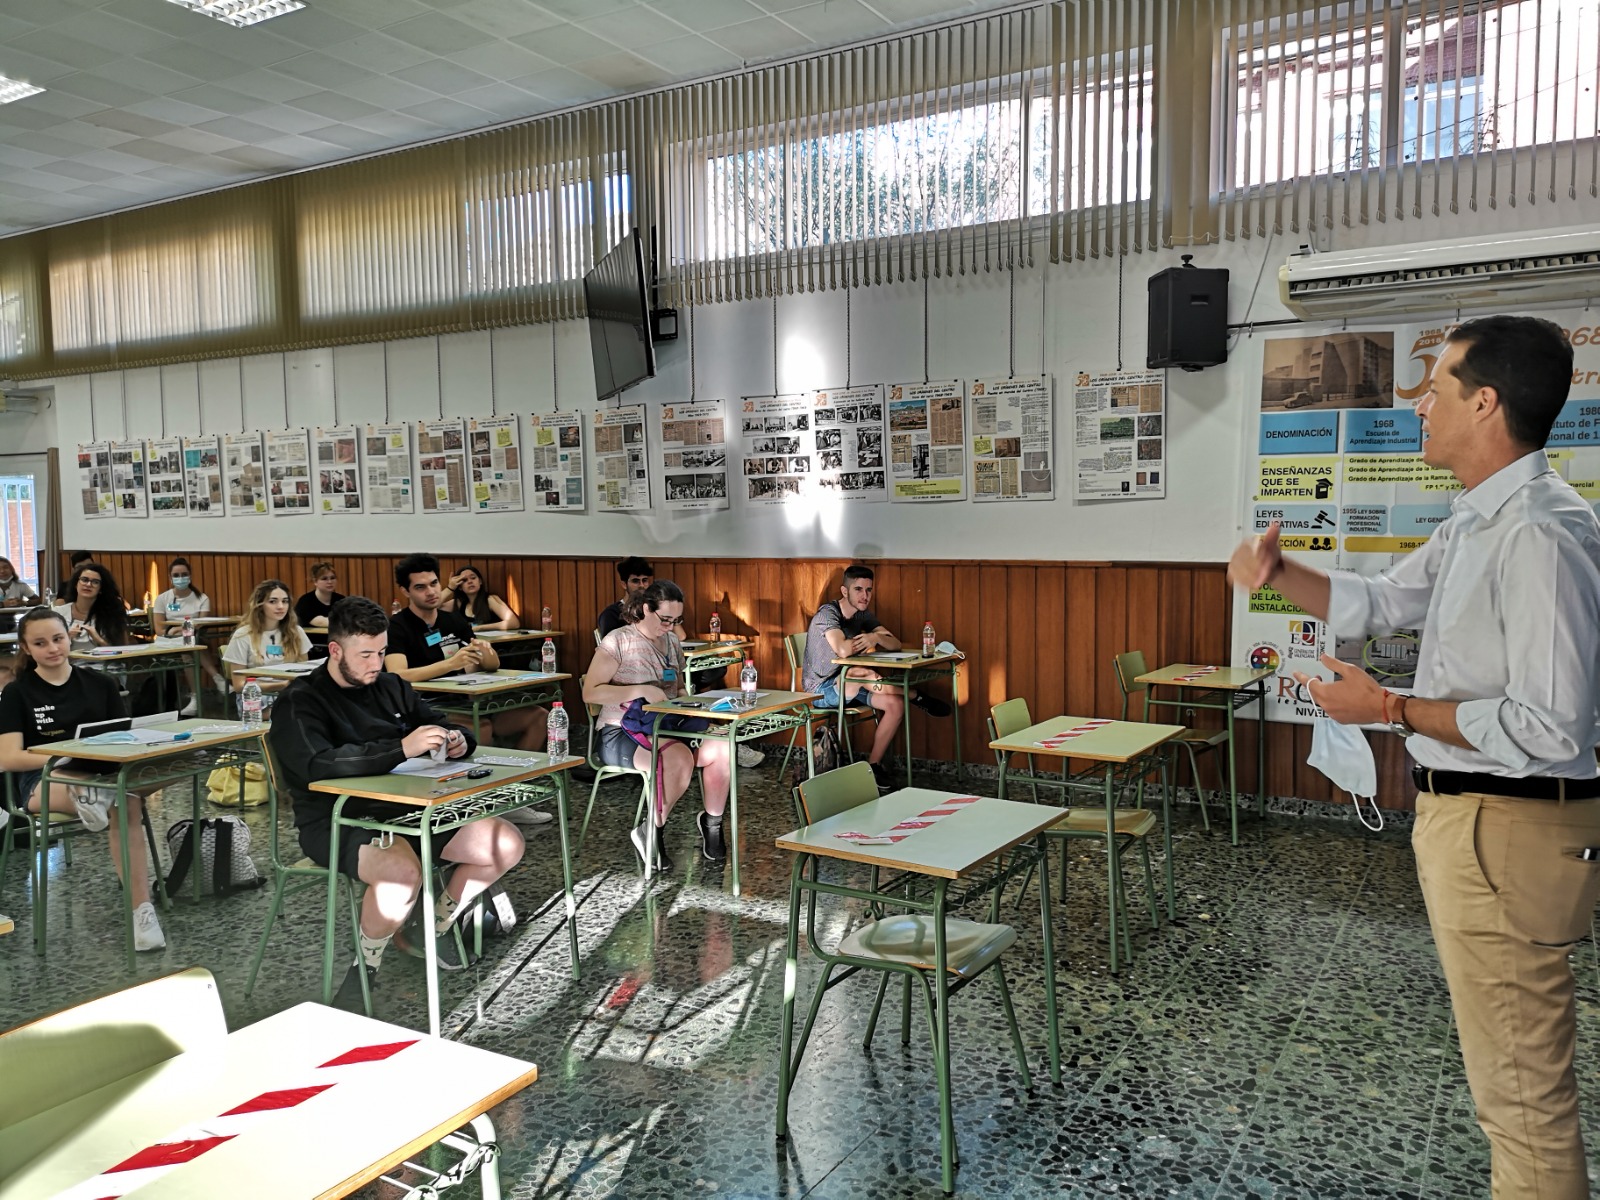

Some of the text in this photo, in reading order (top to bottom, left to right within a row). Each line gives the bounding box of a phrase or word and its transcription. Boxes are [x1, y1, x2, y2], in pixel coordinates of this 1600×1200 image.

[1419, 337, 1442, 345] 2018
[1373, 420, 1394, 428] 1968
[1579, 419, 1590, 427] de
[1265, 427, 1333, 439] DENOMINACIÓN
[1578, 431, 1590, 439] de
[1262, 465, 1332, 476] ENSEÑANZAS
[1261, 478, 1299, 487] QUE SE
[1261, 488, 1313, 496] IMPARTEN
[1256, 510, 1283, 518] LEYES
[1265, 593, 1282, 601] LAS
